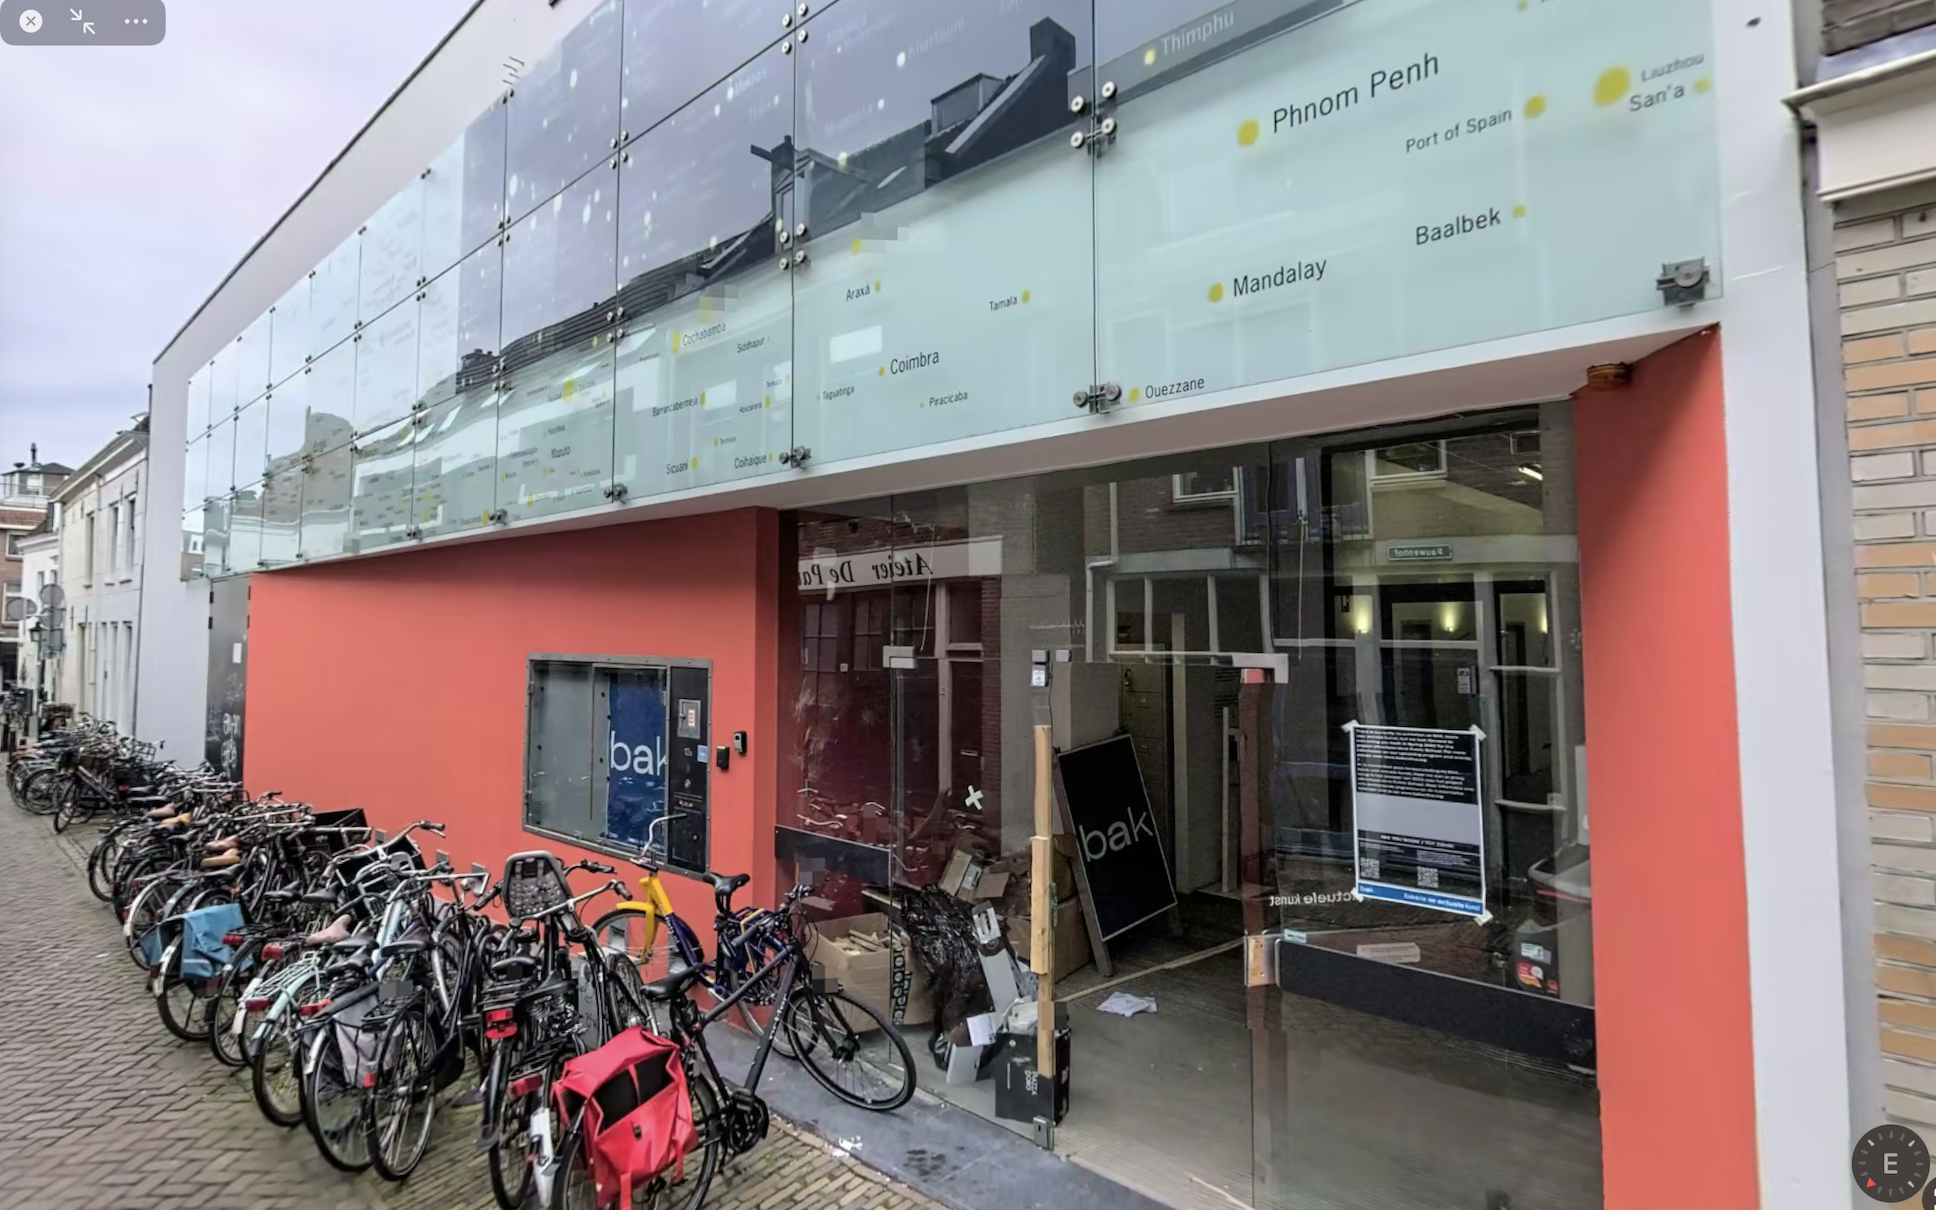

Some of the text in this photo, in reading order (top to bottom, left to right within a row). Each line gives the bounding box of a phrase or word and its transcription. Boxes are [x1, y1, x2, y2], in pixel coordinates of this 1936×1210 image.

[1160, 10, 1235, 56] Thimphu
[1641, 54, 1704, 82] Liuzhou
[1272, 52, 1439, 134] Phnom Penh
[1406, 108, 1513, 154] Port of Spain
[1415, 208, 1502, 246] Baalbek
[1233, 258, 1328, 299] Mandalay
[845, 282, 871, 302] Araxá
[989, 295, 1018, 312] Tamala
[682, 322, 727, 347] Cochabamba
[890, 350, 940, 375] Coimbra
[822, 384, 855, 400] Taguatinga
[929, 390, 968, 407] Piracicaba
[1145, 376, 1206, 399] Ouezzane
[652, 396, 698, 417] Barrancabermeja
[666, 461, 689, 475] Sicuani
[734, 453, 767, 469] Coihaique
[610, 730, 667, 777] bak
[1078, 806, 1155, 863] bak
